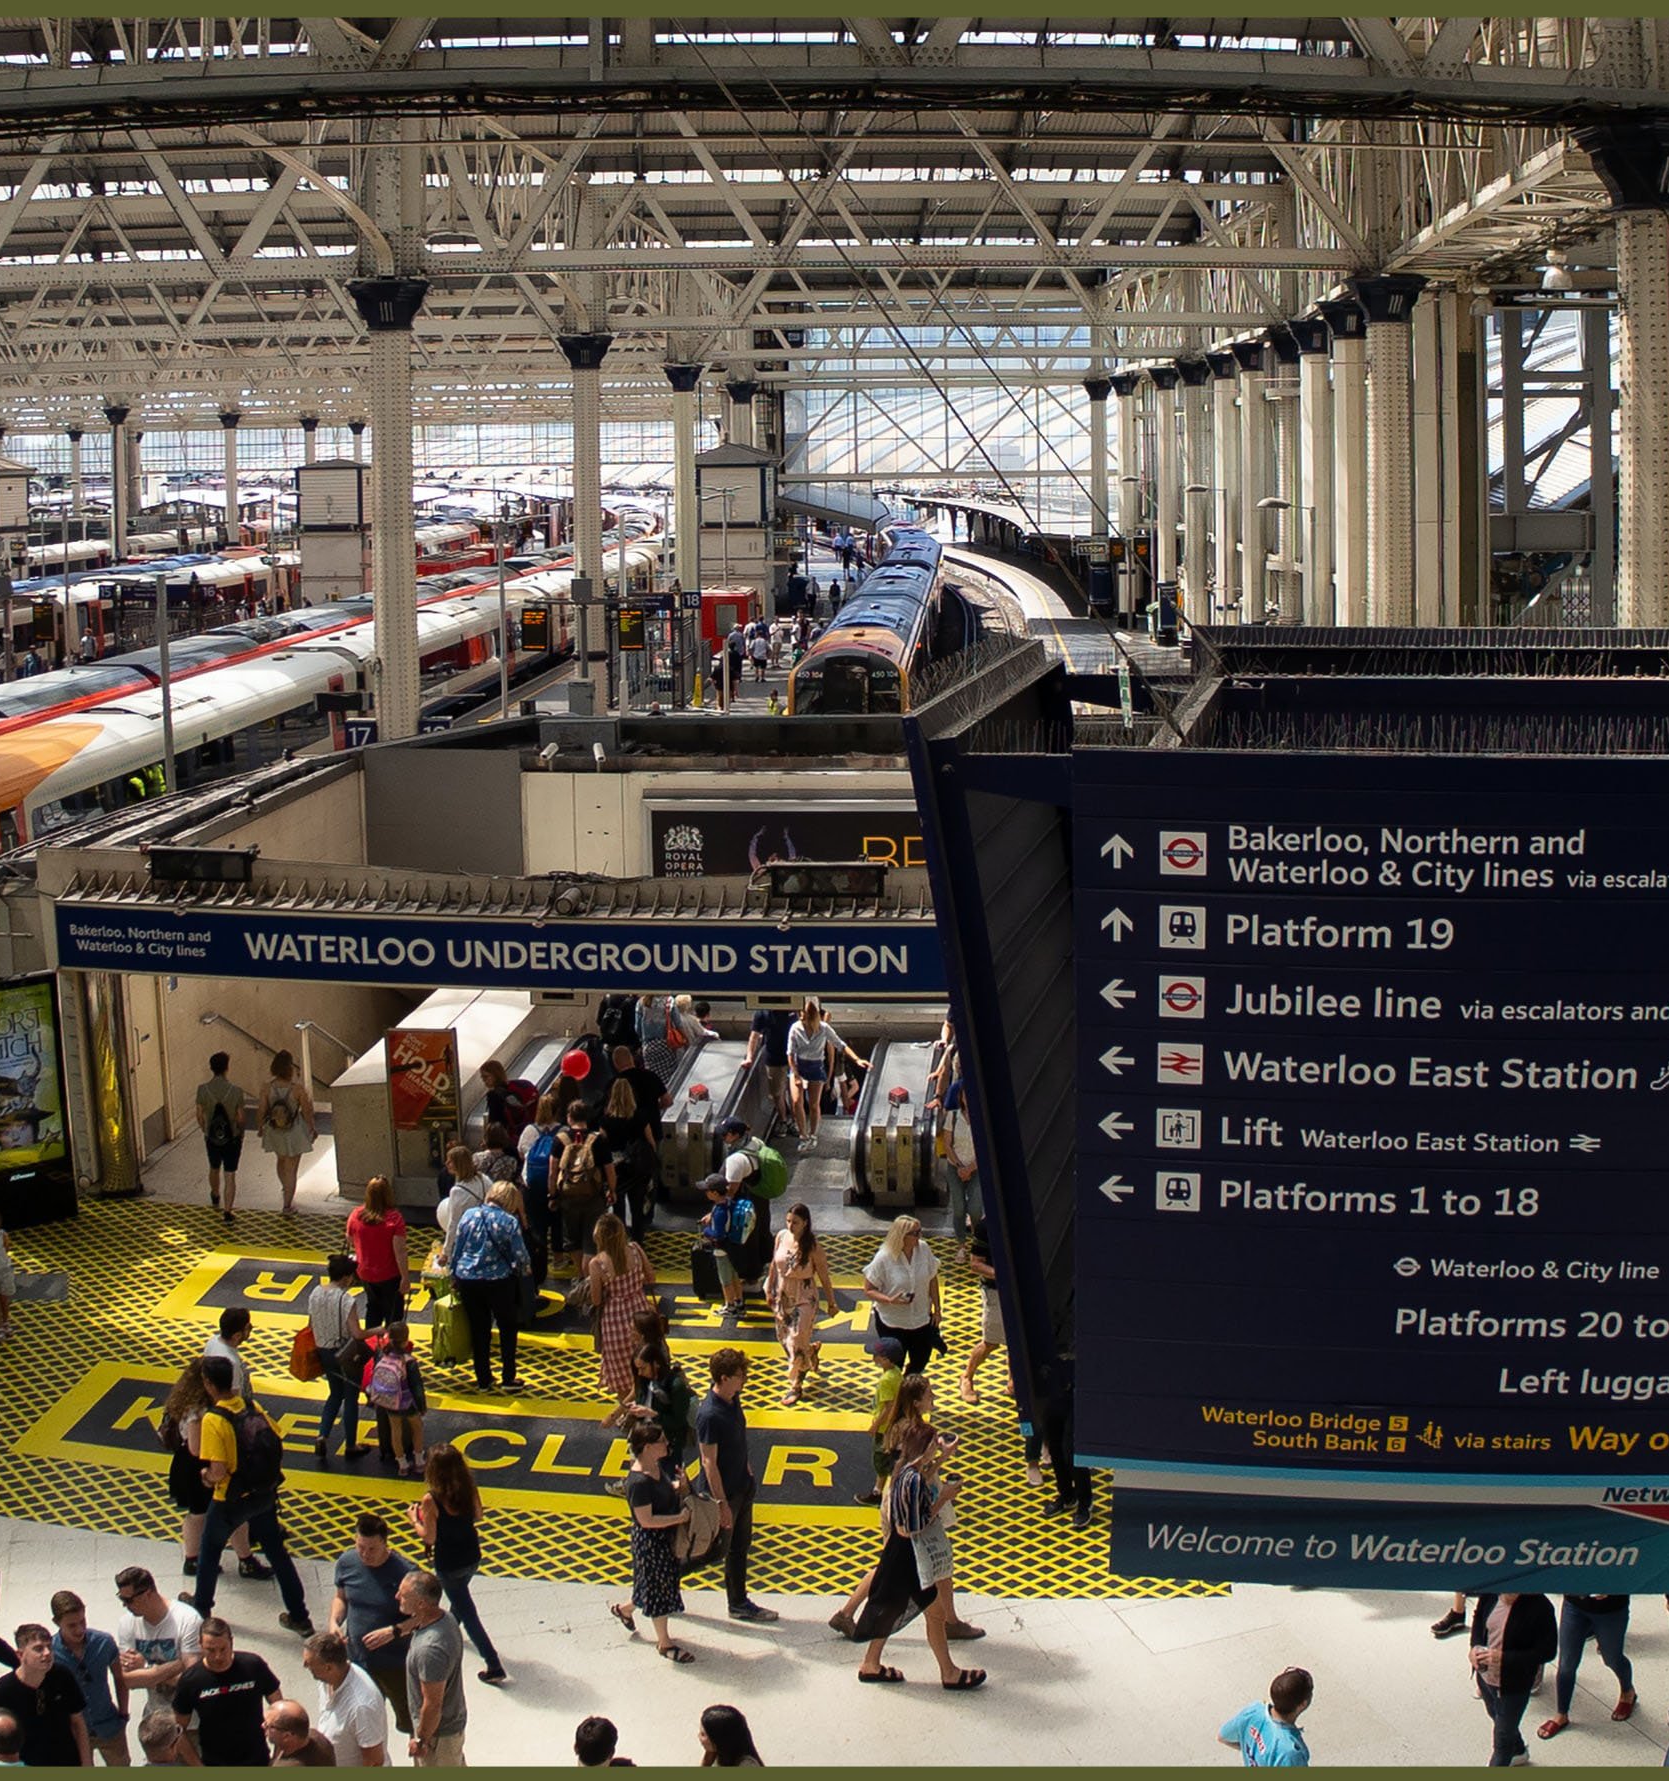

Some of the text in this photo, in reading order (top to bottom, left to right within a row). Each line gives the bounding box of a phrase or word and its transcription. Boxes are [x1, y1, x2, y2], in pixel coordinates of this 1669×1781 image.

[101, 586, 112, 598] 15
[203, 586, 216, 598] 16
[686, 593, 700, 606] 18
[348, 727, 371, 746] 17
[1229, 826, 1585, 856] Bakerloo, Northern and
[664, 862, 704, 870] OPERA
[665, 852, 702, 861] ROYAL
[1228, 857, 1369, 885] Waterloo
[1379, 861, 1401, 886] &
[1413, 861, 1474, 892] City
[1484, 862, 1553, 888] lines
[1567, 871, 1596, 888] via
[70, 924, 211, 942] Bakerloo, Northern and
[1228, 915, 1453, 949] Platform 19
[76, 938, 206, 958] Waterloo & City lines
[243, 932, 908, 974] WATERLOO UNDERGROUND STATION
[1226, 985, 1361, 1018] Jubilee
[1375, 987, 1442, 1019] line
[1461, 1000, 1494, 1020] via
[1501, 1001, 1623, 1020] escalators
[393, 1043, 450, 1092] HOLD
[1224, 1052, 1637, 1090] Waterloo East Station
[1222, 1117, 1558, 1153] Lift Waterloo East Station
[1221, 1181, 1538, 1217] Platforms 1 to 18
[1431, 1258, 1535, 1279] Waterloo
[1542, 1261, 1558, 1279] &
[1567, 1261, 1612, 1283] City
[1620, 1262, 1660, 1279] line
[1395, 1308, 1565, 1338] Platforms
[1578, 1311, 1622, 1338] 20
[1634, 1314, 1669, 1338] to
[1500, 1368, 1570, 1394] Left
[1203, 1406, 1302, 1428] Waterloo
[1310, 1412, 1380, 1435] Bridge
[1253, 1430, 1318, 1449] South
[1326, 1434, 1378, 1452] Bank
[1455, 1434, 1484, 1449] via
[1492, 1435, 1551, 1450] stairs
[1569, 1426, 1639, 1456] Way
[1148, 1523, 1638, 1568] Welcome to Waterloo Station
